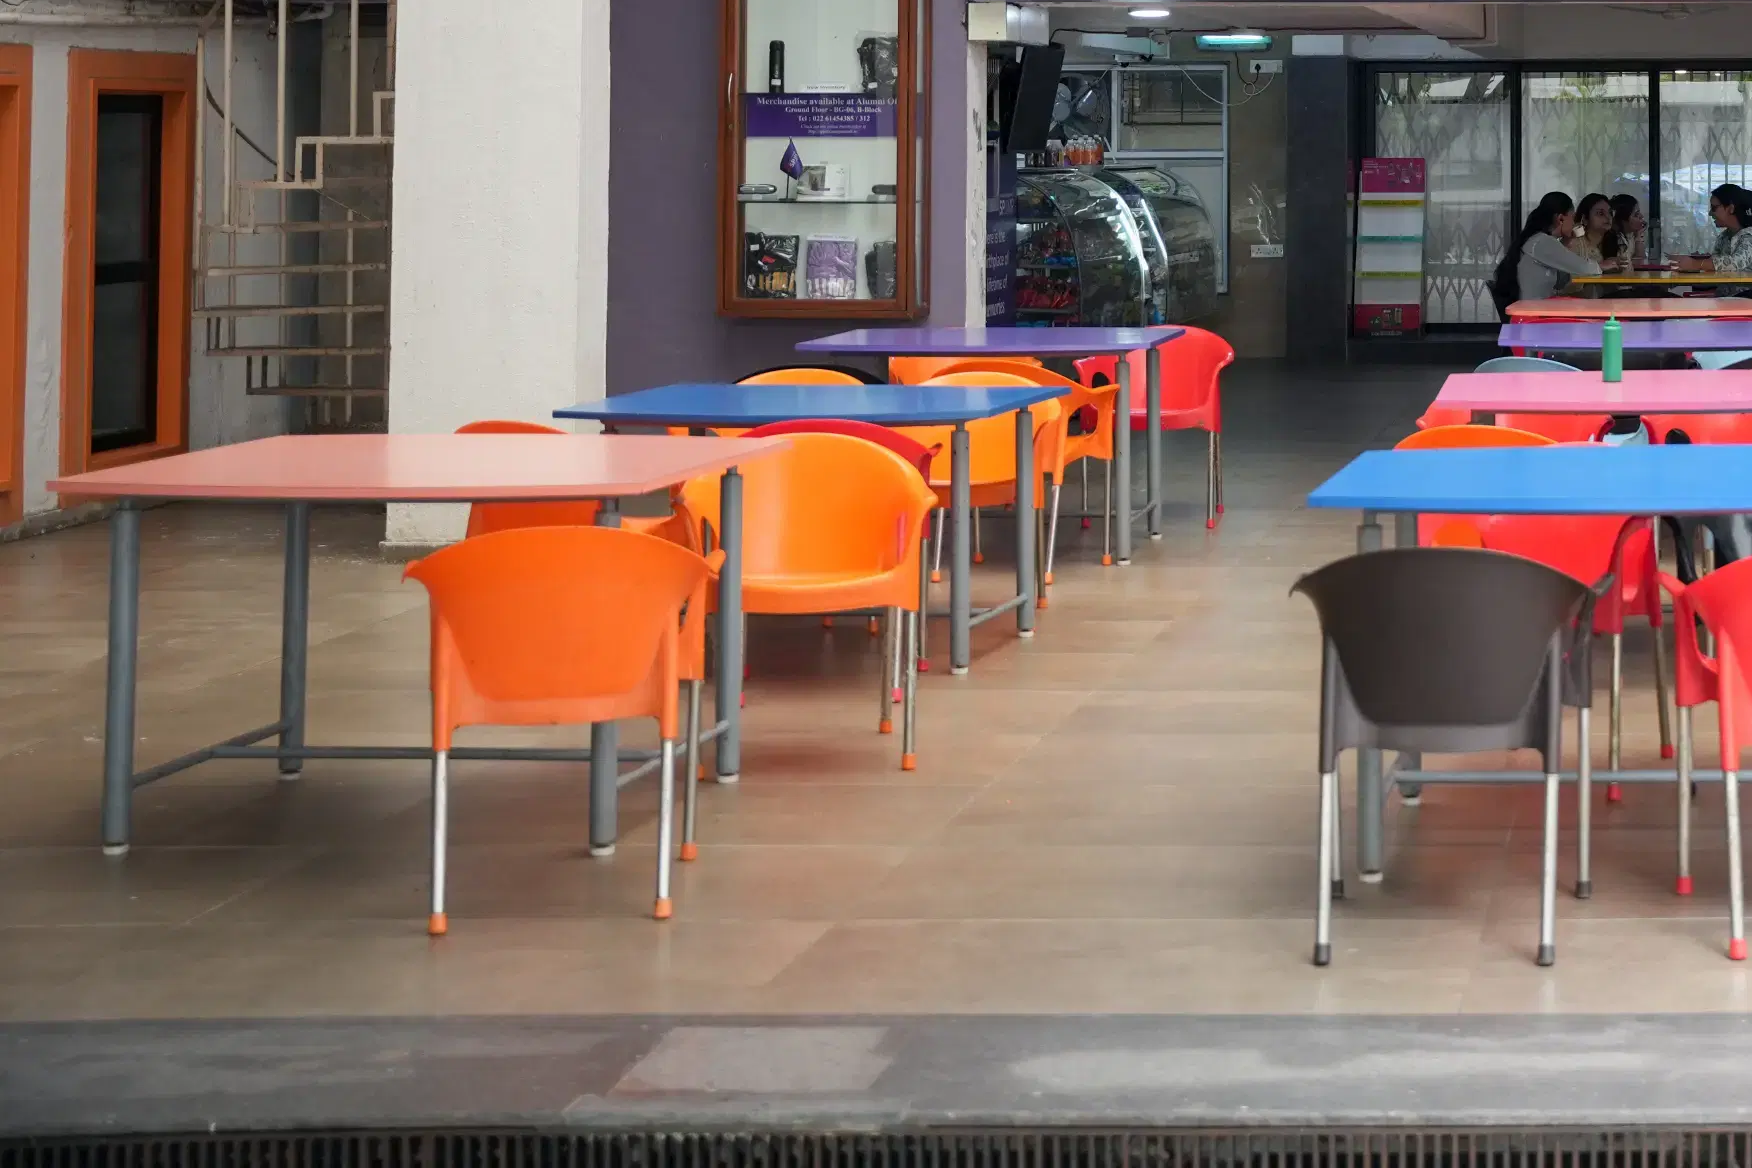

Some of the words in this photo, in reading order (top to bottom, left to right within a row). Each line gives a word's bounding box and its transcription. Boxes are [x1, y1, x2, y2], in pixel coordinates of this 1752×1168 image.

[757, 97, 807, 105] Merchandise
[809, 97, 844, 105] available
[856, 97, 885, 105] Alumni
